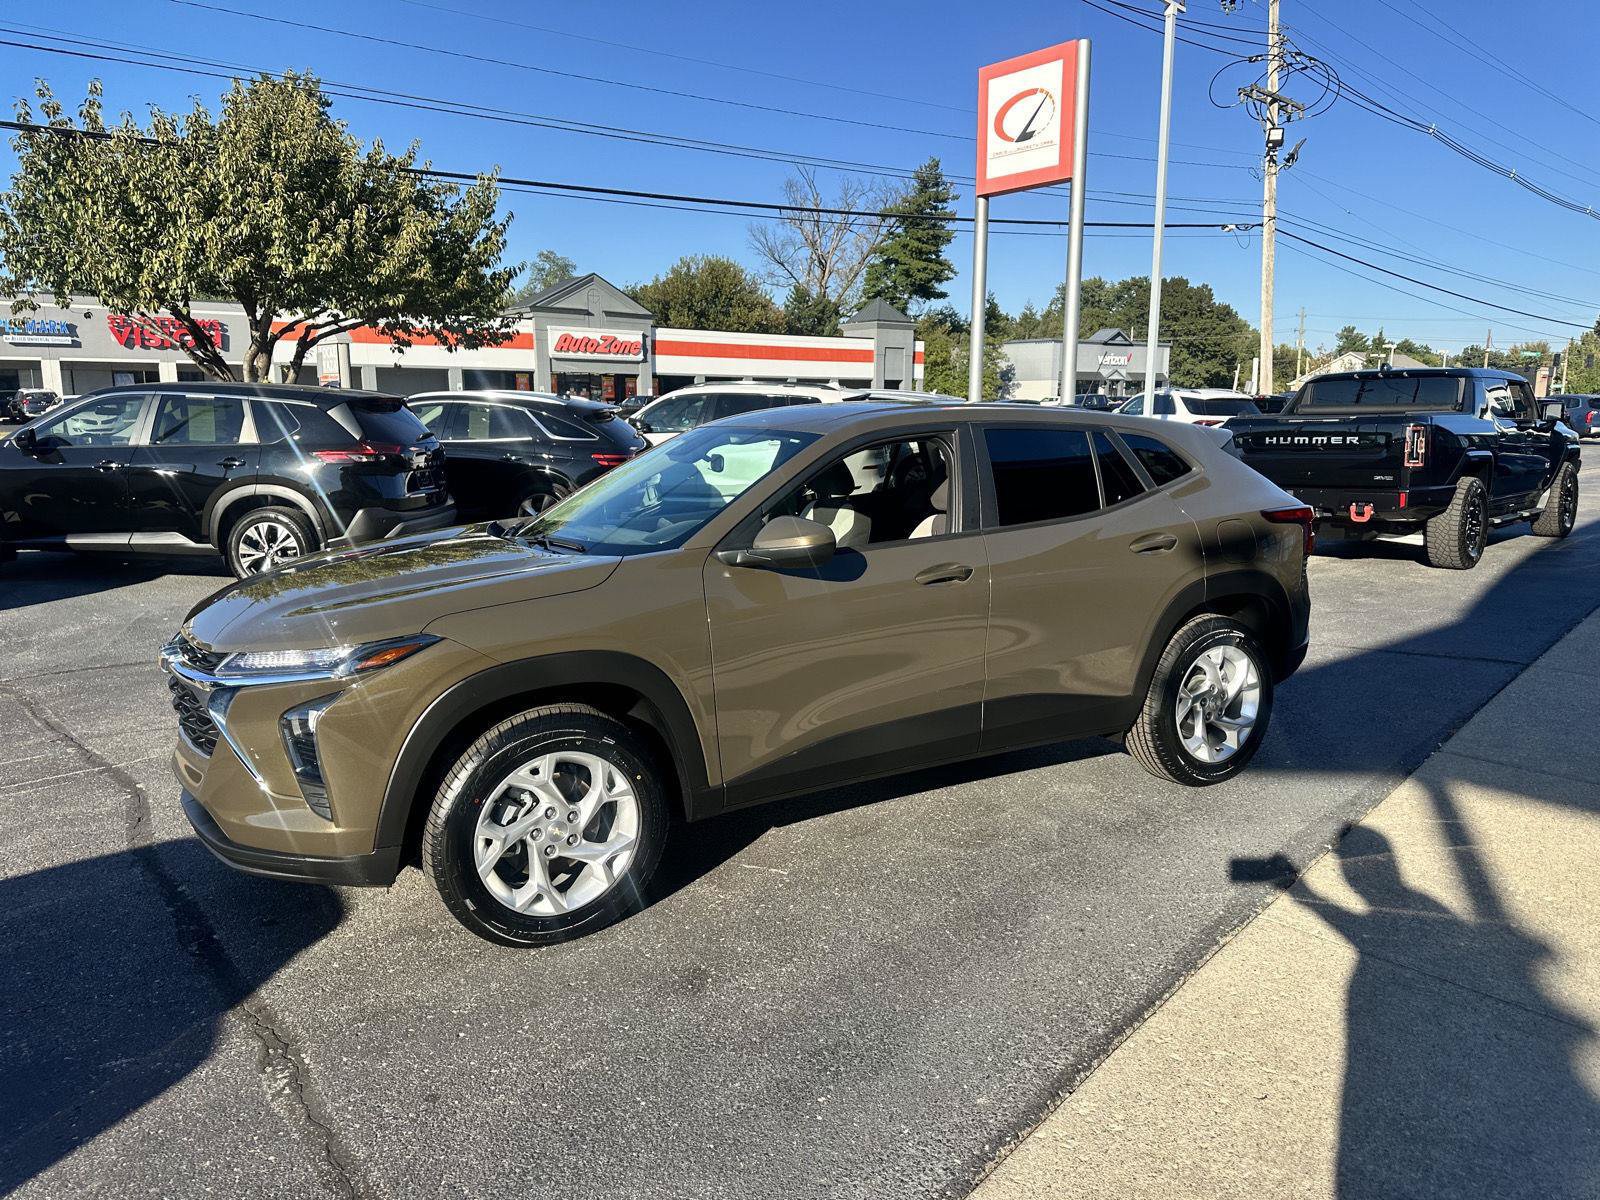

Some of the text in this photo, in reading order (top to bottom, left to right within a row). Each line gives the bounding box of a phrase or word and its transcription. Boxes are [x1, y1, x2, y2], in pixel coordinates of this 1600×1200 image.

[554, 333, 642, 356] AutoZone
[1097, 353, 1129, 366] verizon
[1265, 436, 1359, 445] HUMMER
